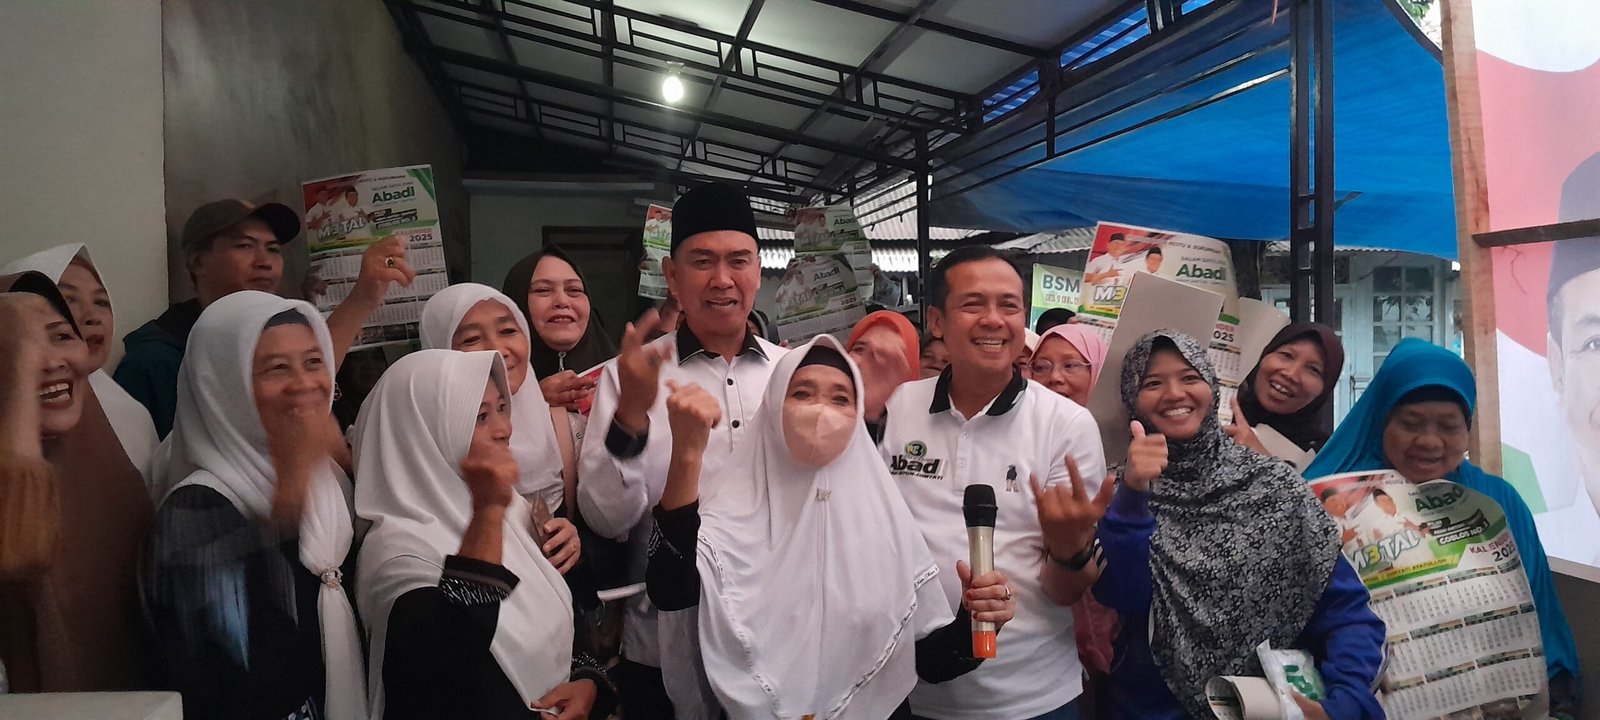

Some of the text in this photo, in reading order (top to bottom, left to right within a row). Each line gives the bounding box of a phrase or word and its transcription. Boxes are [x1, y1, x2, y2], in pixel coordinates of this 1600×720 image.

[409, 234, 433, 242] 2025
[1042, 273, 1080, 294] BSM
[1094, 286, 1127, 302] M3
[1213, 330, 1234, 342] 025
[1439, 530, 1471, 544] COBLOS
